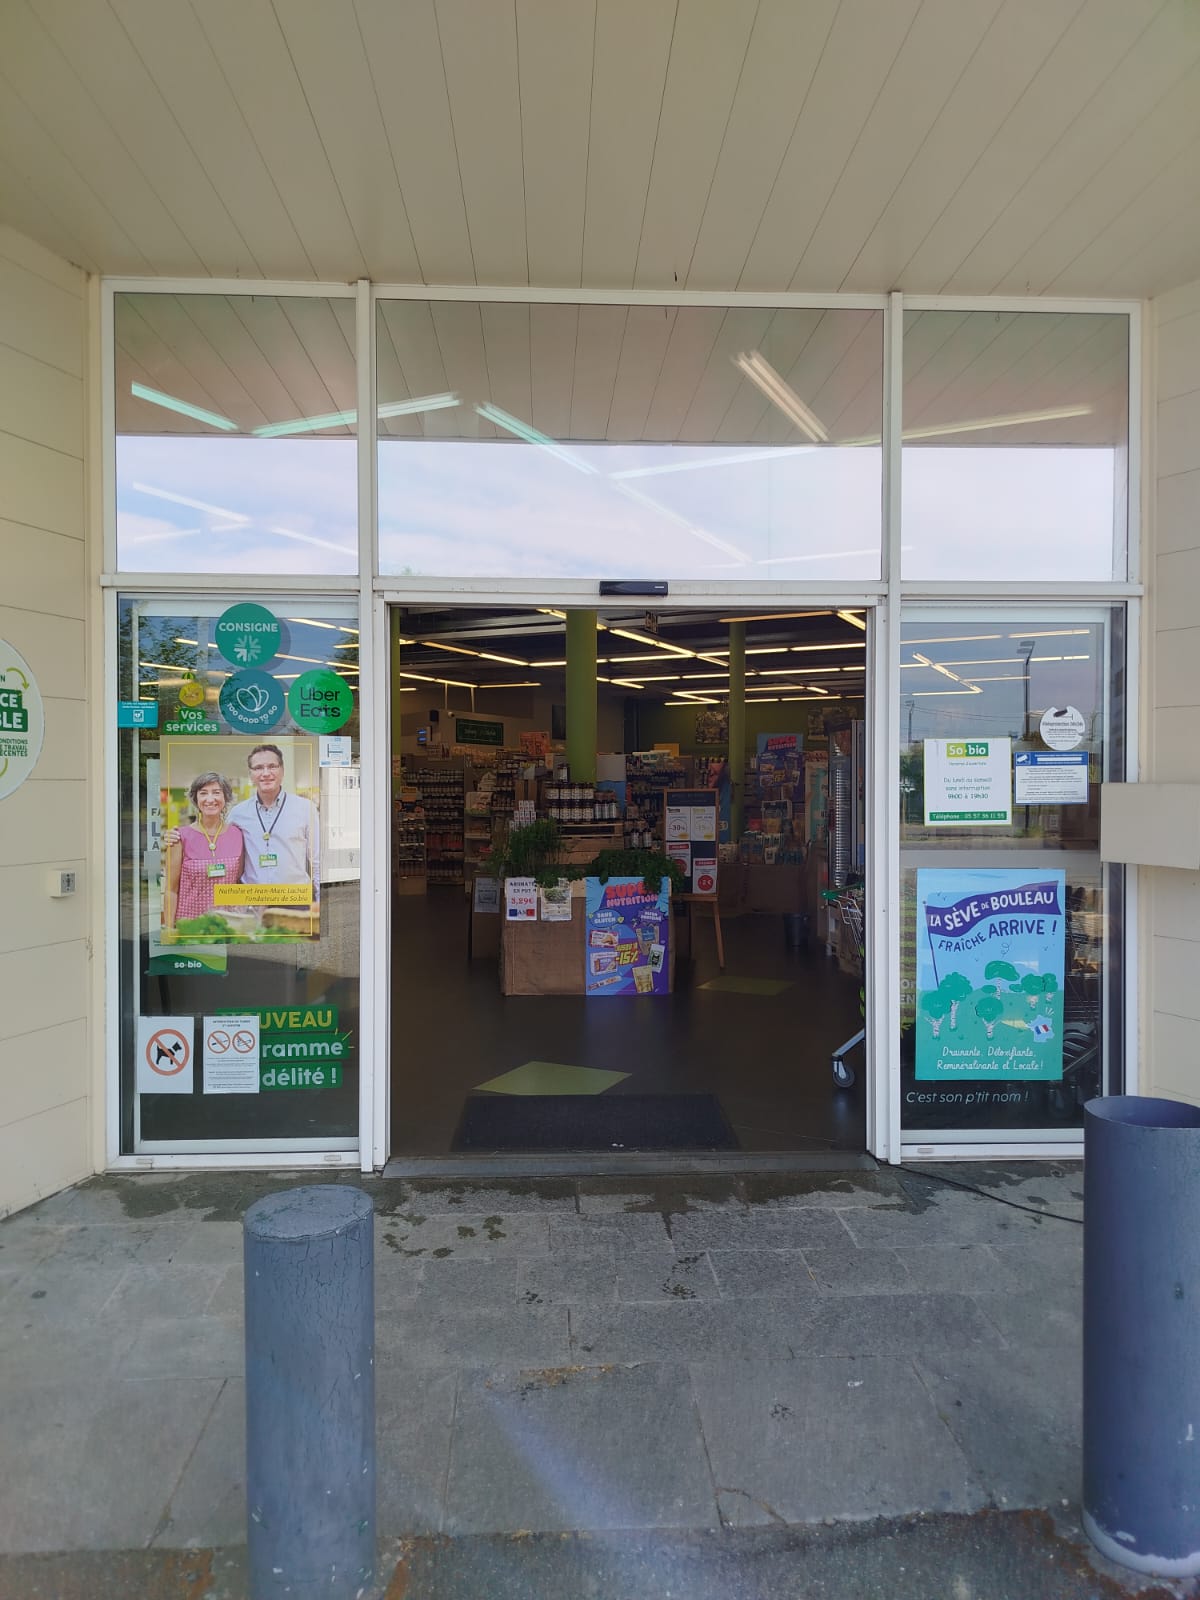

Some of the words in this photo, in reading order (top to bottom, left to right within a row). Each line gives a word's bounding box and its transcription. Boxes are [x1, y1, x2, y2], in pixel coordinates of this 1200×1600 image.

[219, 623, 278, 632] CONSIGNE
[300, 687, 340, 701] Uber
[180, 710, 203, 720] Vos
[226, 702, 239, 716] TOO
[238, 714, 259, 724] GOOD
[259, 713, 269, 721] TO
[268, 705, 278, 715] GO
[300, 704, 340, 717] Eats
[0, 712, 23, 728] LE
[166, 721, 217, 732] services
[606, 894, 660, 908] NUTRITION
[930, 914, 941, 927] LA
[944, 906, 981, 931] SÈVE
[990, 891, 1054, 911] BOULEAU
[938, 932, 986, 952] FRAÎCHE
[988, 919, 1045, 939] ARRIVE
[1051, 920, 1057, 936] !
[906, 1091, 937, 1103] C'est
[939, 1093, 962, 1103] son
[965, 1091, 989, 1105] p'tit
[992, 1093, 1021, 1103] nom
